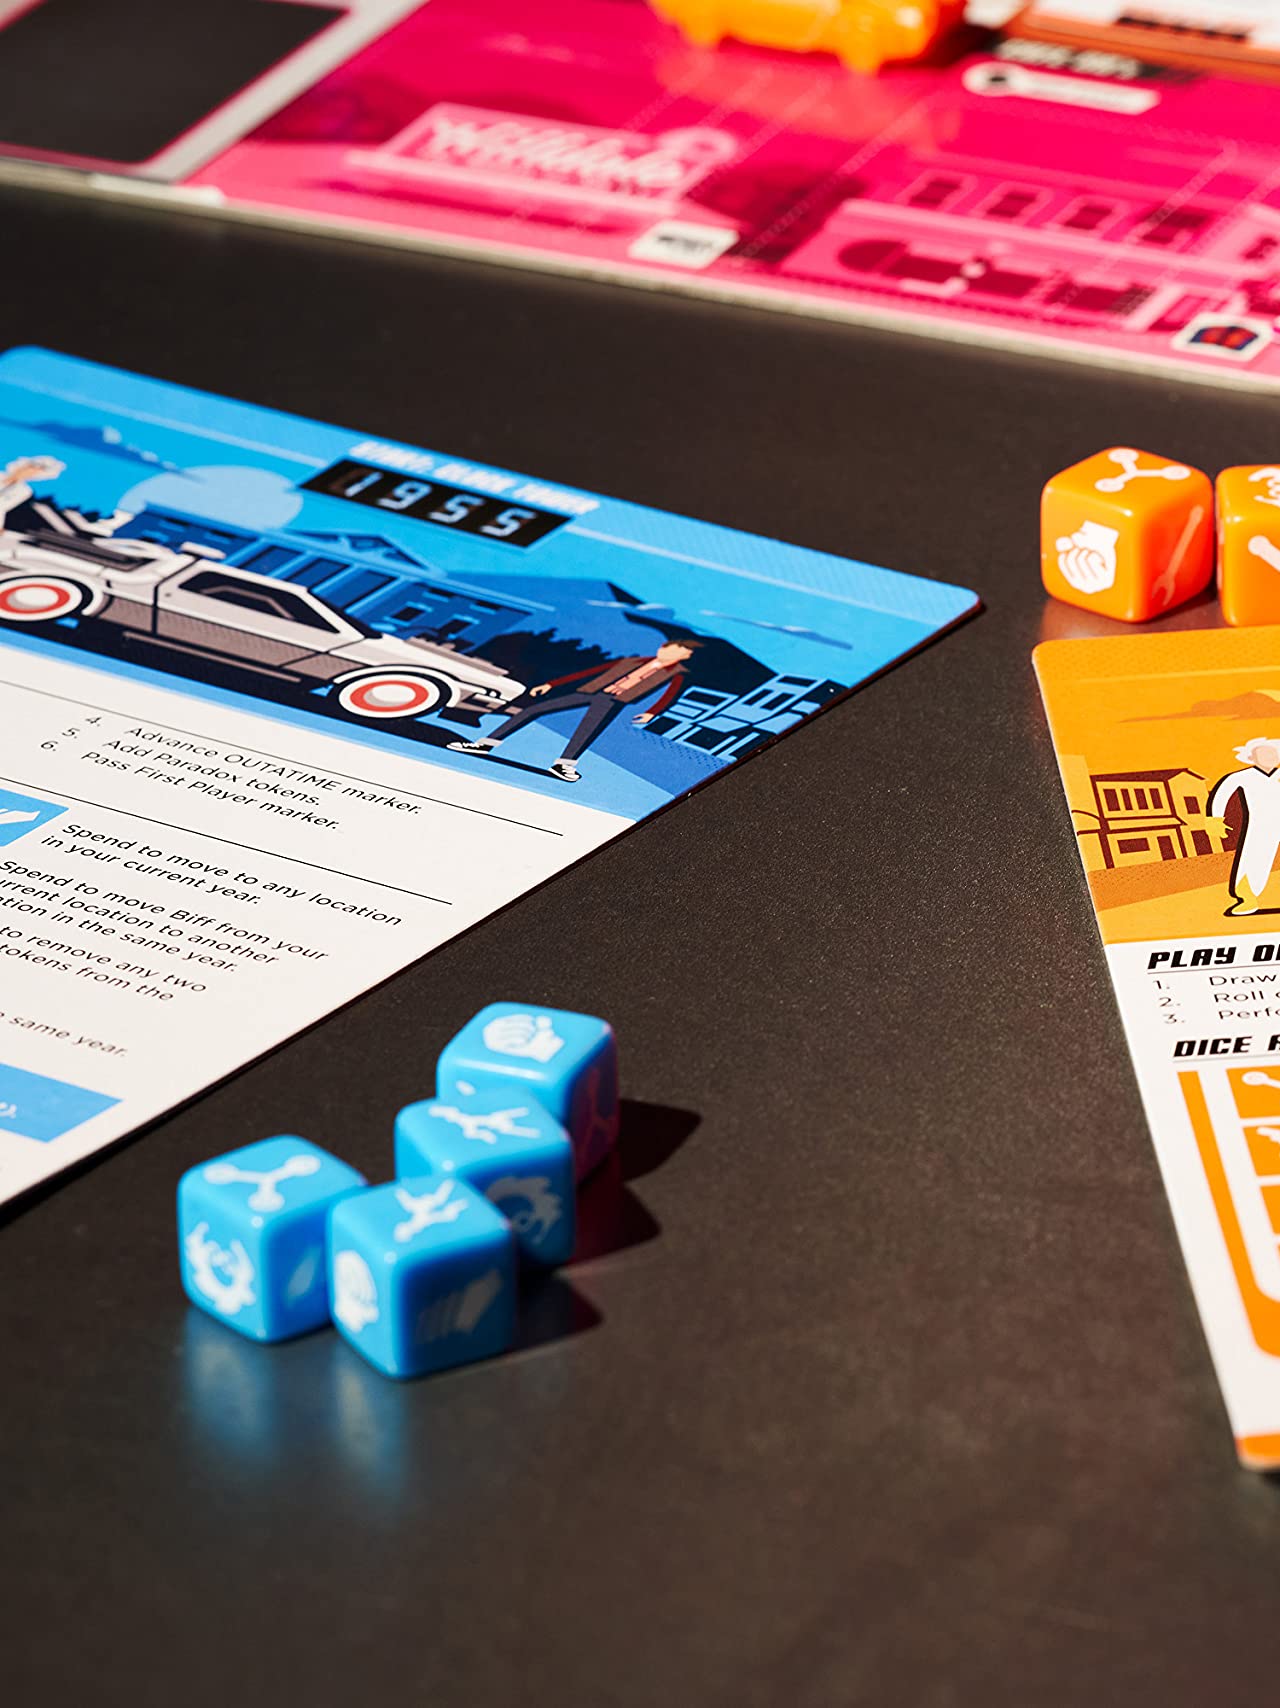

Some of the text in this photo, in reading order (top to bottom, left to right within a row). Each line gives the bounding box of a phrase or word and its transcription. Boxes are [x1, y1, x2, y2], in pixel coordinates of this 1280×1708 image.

[344, 471, 537, 537] 1955
[39, 740, 340, 830] 6. Pass First Player marker.
[60, 726, 320, 807] 5. Add Paradox tokens.
[84, 716, 423, 815] 4. Advance OUTATIME marker.
[40, 834, 262, 905] in your current year.
[61, 823, 403, 926] Spend to move to any location
[0, 859, 329, 960] Spend to move Biff from your
[0, 878, 280, 964] rrent location to another
[49, 910, 75, 925] in
[77, 918, 117, 937] the
[118, 932, 181, 955] same
[181, 950, 238, 973] year.
[0, 925, 207, 992] to remove any two
[74, 965, 131, 989] from
[134, 983, 174, 1001] the
[1146, 945, 1238, 971] PLAY
[1151, 978, 1171, 991] 1.
[1207, 973, 1278, 987] Draw
[8, 1016, 71, 1039] same
[1157, 995, 1181, 1008] 2.
[1212, 989, 1265, 1004] Roll
[1161, 1012, 1186, 1025] 3.
[1172, 1034, 1253, 1058] DICE
